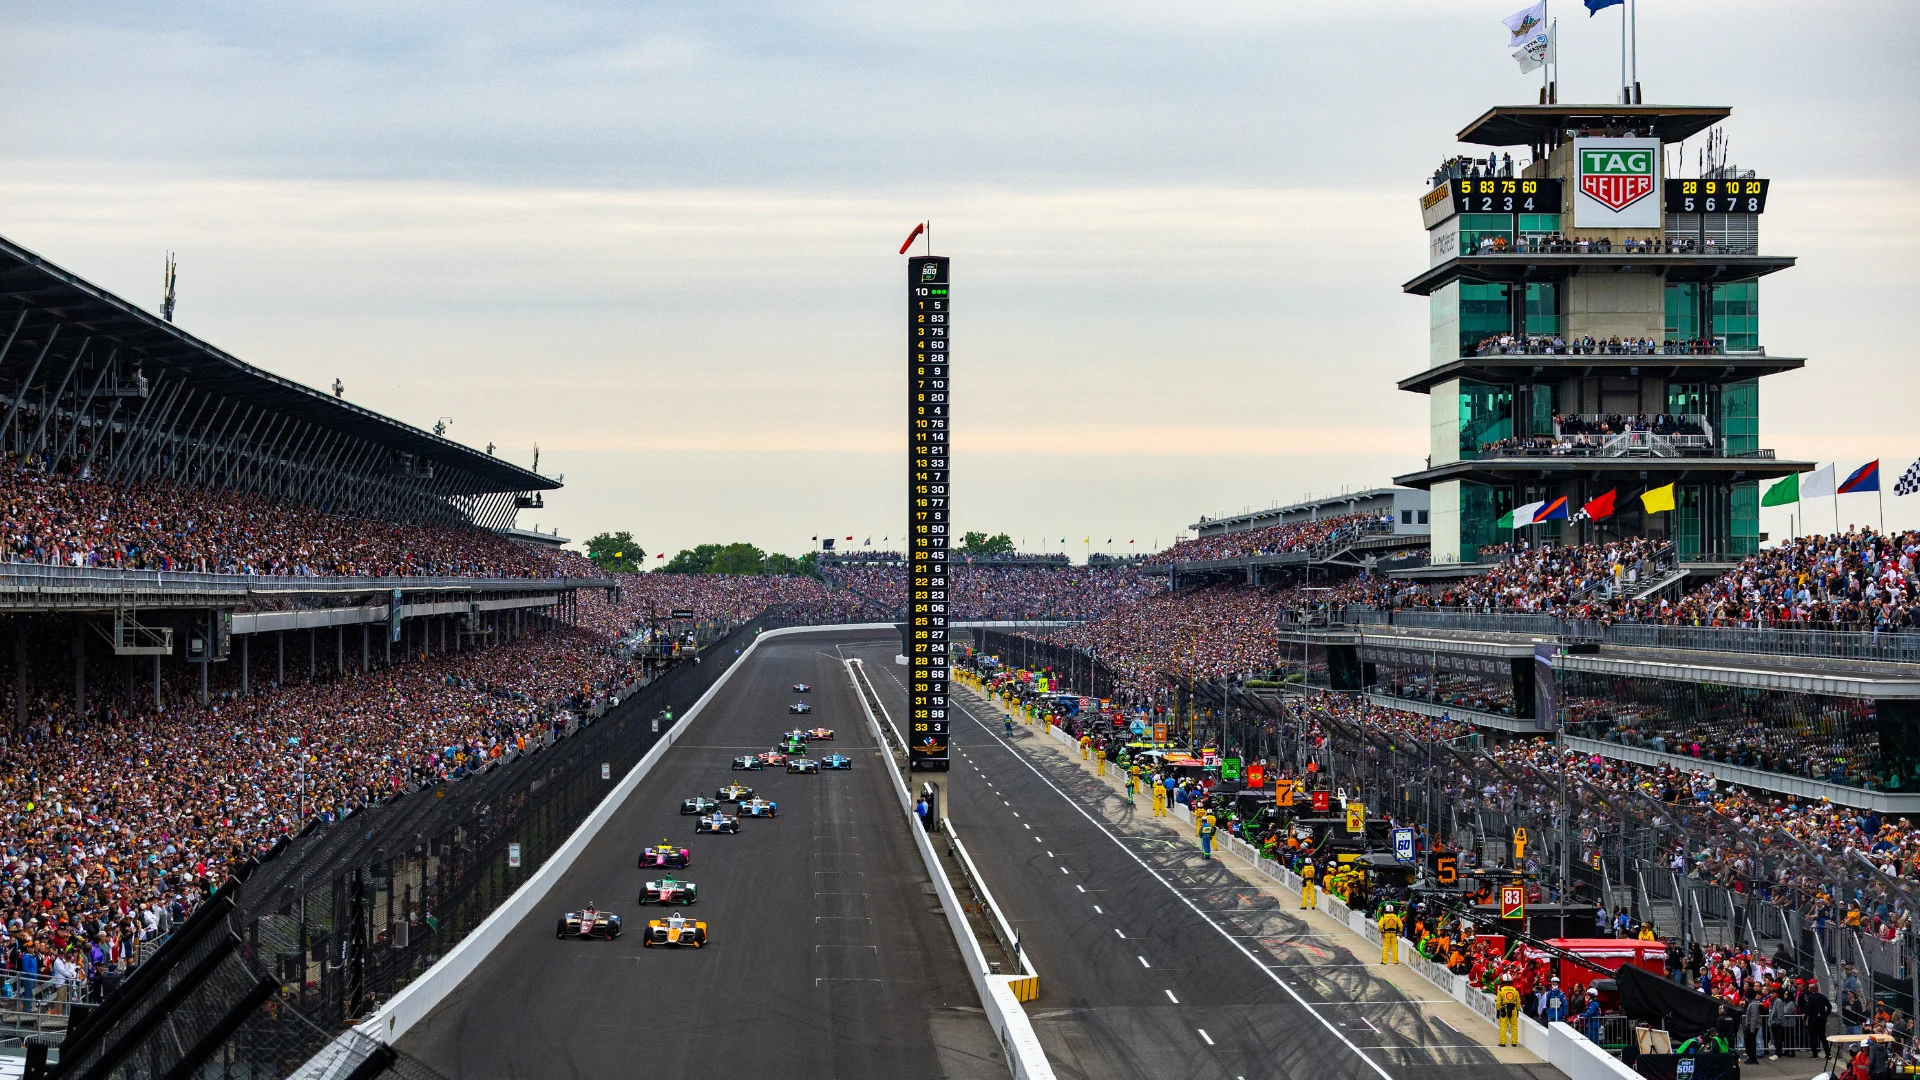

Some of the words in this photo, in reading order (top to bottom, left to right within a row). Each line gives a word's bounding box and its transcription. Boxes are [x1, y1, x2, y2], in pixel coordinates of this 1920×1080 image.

[1587, 154, 1646, 171] TAG
[1461, 181, 1471, 193] 5
[1480, 181, 1494, 193] 83
[1502, 181, 1516, 193] 75
[1522, 181, 1536, 193] 60
[1682, 181, 1697, 194] 28
[1706, 182, 1716, 194] 9
[1726, 182, 1739, 194] 10
[1746, 182, 1760, 194] 20
[1586, 178, 1648, 205] HEUER
[1462, 197, 1469, 210] 1
[1482, 197, 1492, 210] 2
[1504, 197, 1512, 211] 3
[1524, 198, 1534, 211] 4
[1685, 198, 1694, 211] 5
[1706, 198, 1715, 211] 6
[1728, 198, 1736, 211] 7
[1748, 198, 1758, 211] 8
[916, 287, 928, 296] 10
[919, 301, 923, 310] 1
[935, 301, 940, 310] 5
[918, 315, 924, 323] 2
[932, 315, 944, 323] 83
[918, 328, 924, 336] 3
[932, 328, 943, 336] 75
[918, 341, 924, 349] 4
[931, 341, 944, 349] 60
[919, 354, 924, 362] 5
[931, 354, 944, 362] 28
[918, 367, 924, 376] 6
[935, 367, 940, 376] 9
[919, 380, 924, 389] 7
[933, 380, 943, 389] 10
[918, 394, 924, 402] 8
[931, 394, 944, 402] 20
[918, 407, 924, 415] 9
[934, 407, 941, 415] 4
[916, 420, 927, 428] 10
[932, 420, 943, 428] 76
[916, 433, 926, 441] 11
[933, 433, 943, 441] 14
[916, 446, 927, 454] 12
[932, 446, 942, 454] 21
[917, 460, 927, 468] 13
[931, 460, 944, 468] 33
[916, 473, 927, 481] 14
[935, 473, 940, 481] 7
[916, 486, 927, 494] 15
[932, 486, 944, 494] 30
[917, 499, 927, 507] 16
[932, 499, 943, 507] 77
[917, 512, 927, 520] 17
[935, 512, 941, 520] 8
[917, 525, 927, 534] 18
[932, 525, 944, 534] 90
[917, 538, 927, 547] 19
[933, 538, 943, 547] 17
[916, 552, 928, 560] 20
[932, 552, 944, 560] 45
[916, 565, 926, 573] 21
[935, 565, 941, 573] 6
[916, 578, 928, 586] 22
[932, 578, 944, 586] 26
[916, 591, 928, 600] 23
[932, 591, 944, 600] 23
[916, 604, 928, 613] 24
[932, 604, 944, 613] 06
[916, 618, 927, 626] 25
[933, 618, 944, 626] 12
[916, 631, 927, 639] 26
[932, 631, 943, 639] 27
[916, 644, 927, 652] 27
[932, 644, 944, 652] 24
[916, 657, 928, 665] 28
[933, 657, 944, 665] 18
[916, 670, 927, 678] 29
[932, 670, 944, 678] 66
[915, 684, 928, 692] 30
[935, 684, 941, 692] 2
[916, 697, 926, 705] 31
[933, 697, 943, 705] 15
[915, 710, 927, 718] 32
[932, 710, 944, 718] 98
[915, 723, 927, 731] 33
[935, 723, 941, 731] 3
[1398, 840, 1410, 850] 60
[1438, 858, 1456, 882] 5
[1505, 891, 1519, 904] 83
